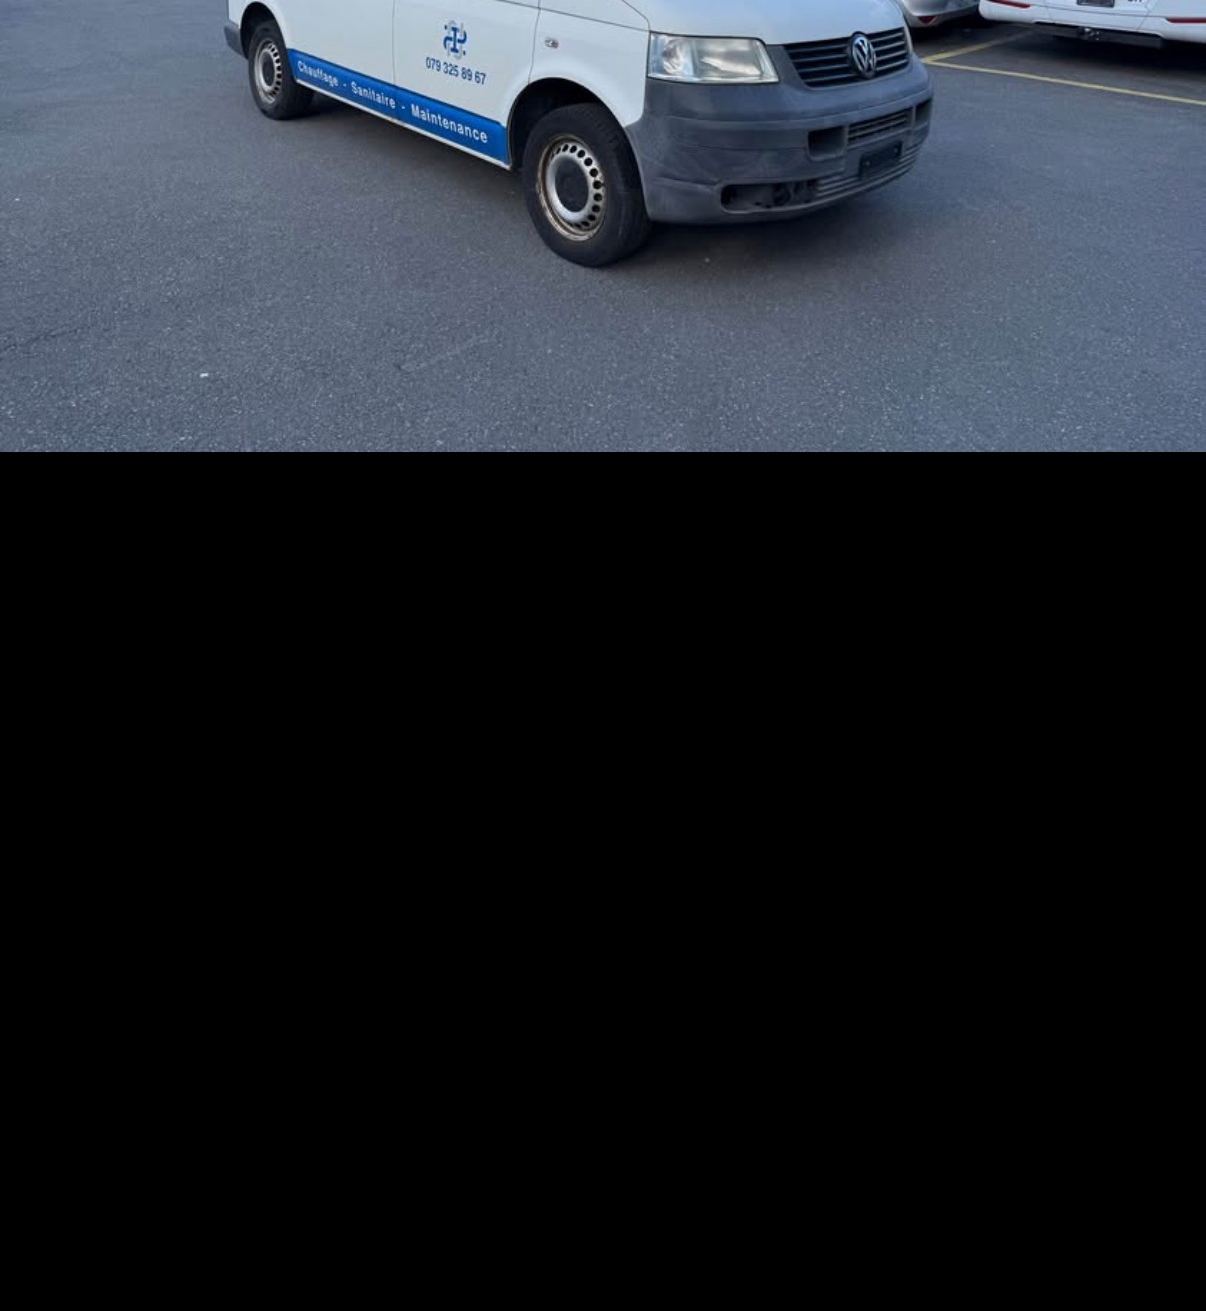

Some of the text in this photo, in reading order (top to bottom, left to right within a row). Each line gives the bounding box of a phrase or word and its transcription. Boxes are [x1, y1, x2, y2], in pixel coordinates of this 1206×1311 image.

[425, 56, 486, 85] 079 325 89 67
[297, 60, 339, 87] Chauffage
[350, 80, 396, 109] Sanitaire
[411, 103, 488, 144] Maintenance
